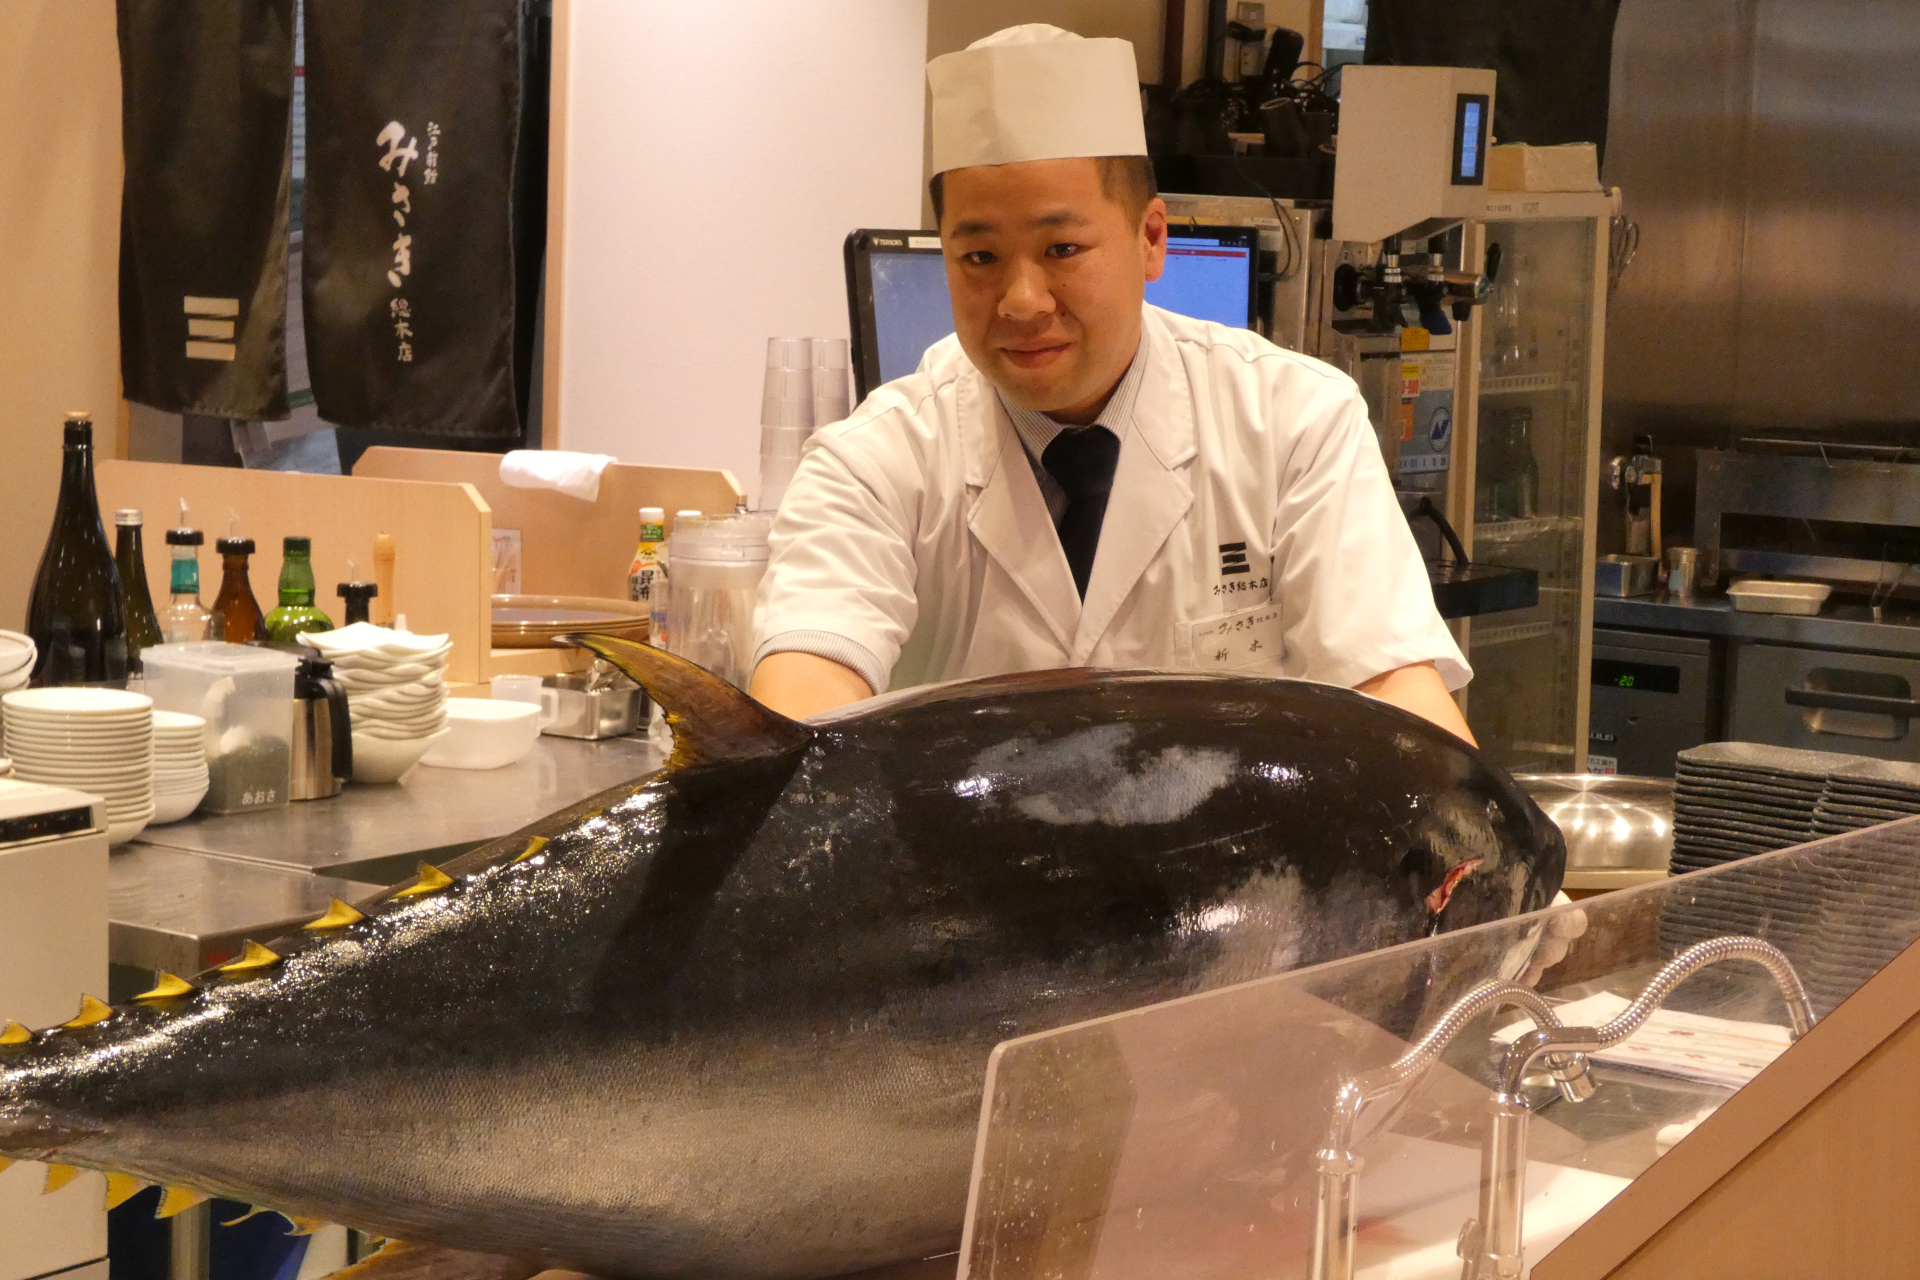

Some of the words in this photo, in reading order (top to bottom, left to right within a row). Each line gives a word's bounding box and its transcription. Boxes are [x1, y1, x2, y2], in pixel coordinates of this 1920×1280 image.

[1213, 577, 1268, 596] みさき総本店
[241, 789, 276, 806] あおさ
